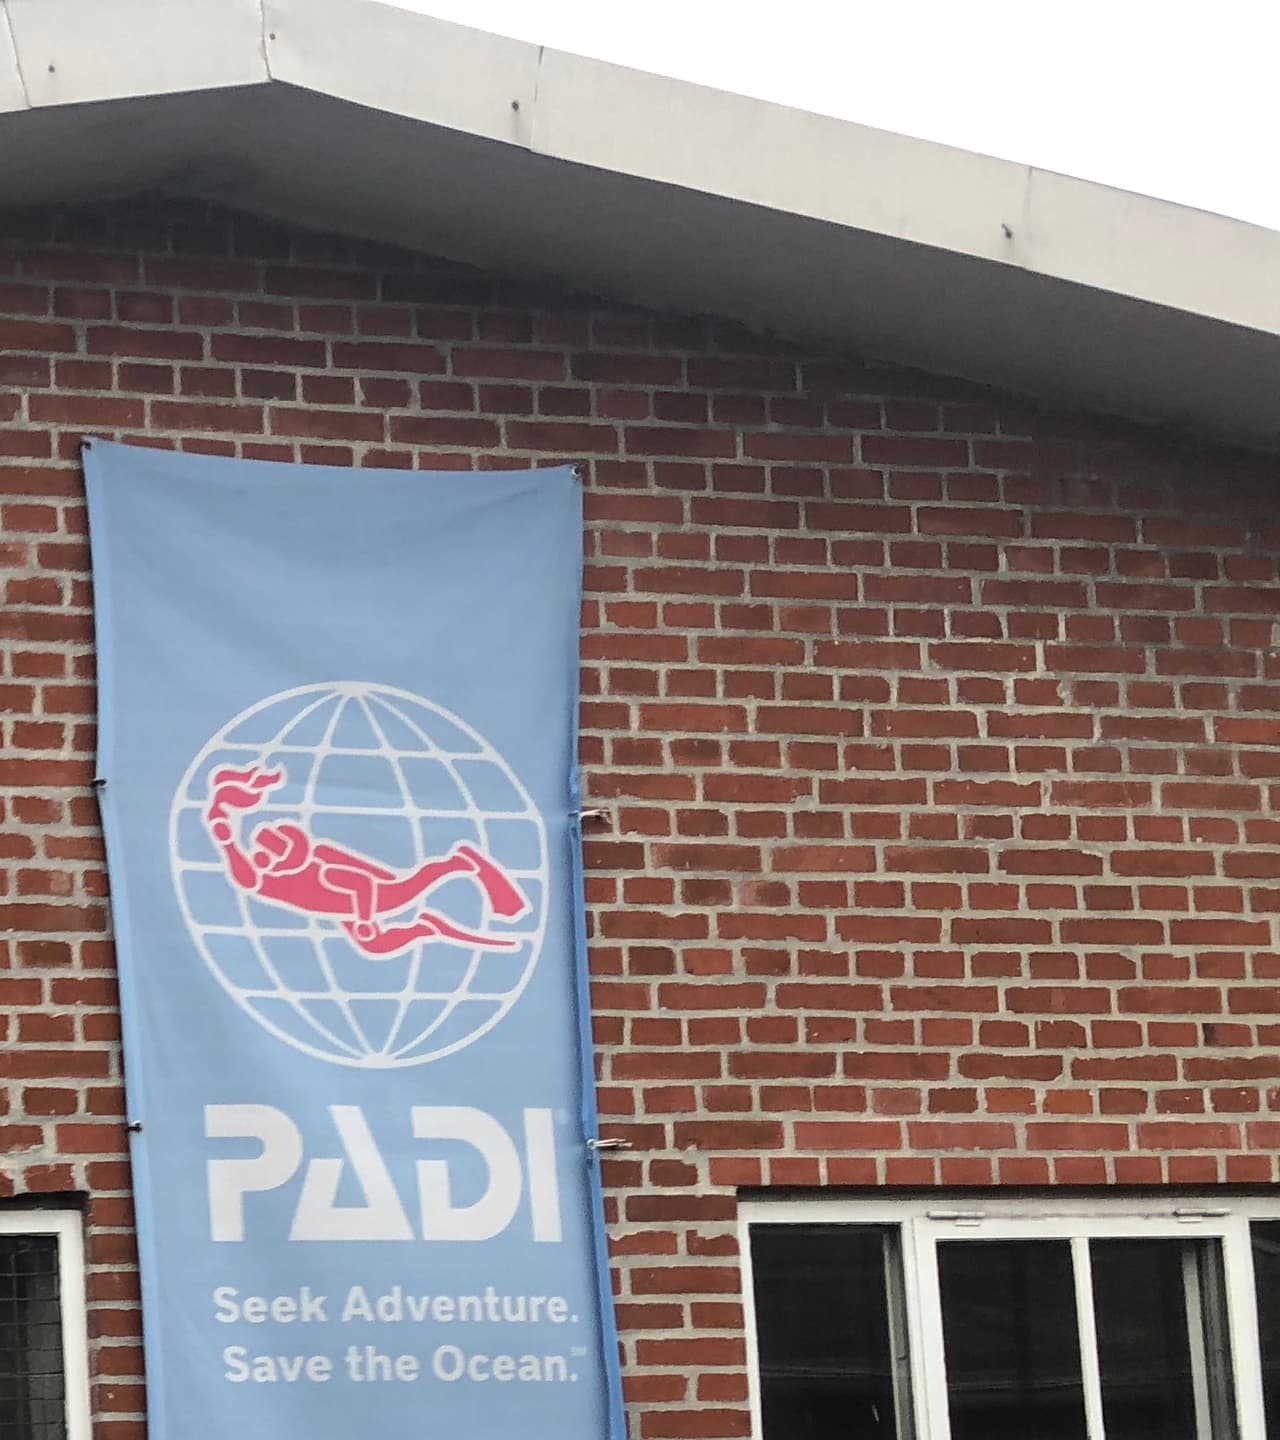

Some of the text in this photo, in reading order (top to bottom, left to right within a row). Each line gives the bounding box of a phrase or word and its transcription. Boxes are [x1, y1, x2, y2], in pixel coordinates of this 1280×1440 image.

[204, 1103, 563, 1243] PADI
[212, 1285, 580, 1324] Seek Adventure.
[222, 1343, 580, 1383] Save the Ocean.
